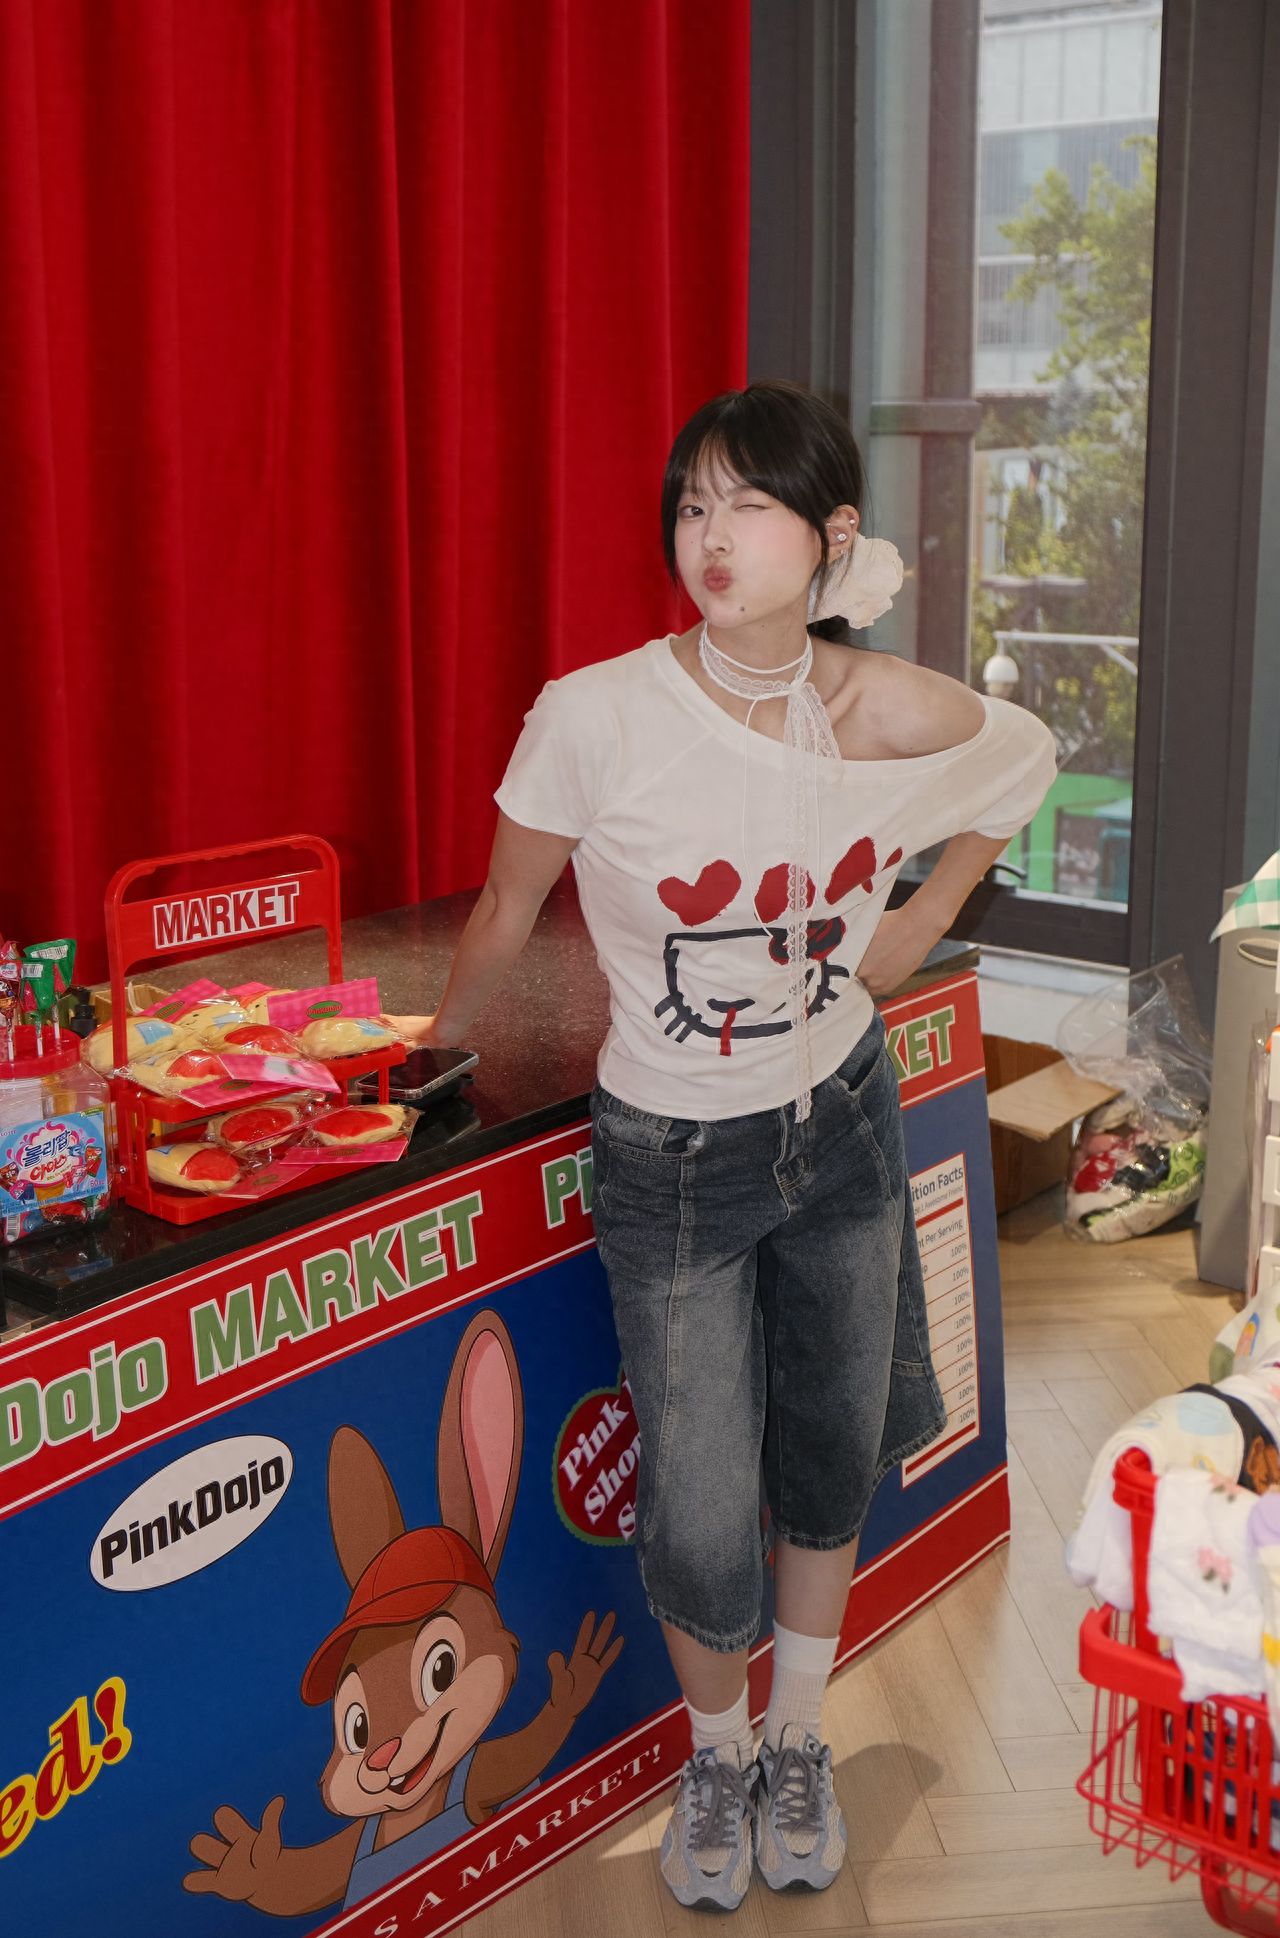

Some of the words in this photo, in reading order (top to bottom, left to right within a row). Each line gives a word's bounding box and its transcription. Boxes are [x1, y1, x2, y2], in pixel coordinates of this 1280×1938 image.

[153, 881, 300, 949] MARKET
[190, 1190, 483, 1386] MARKET
[885, 1004, 955, 1083] KET
[911, 1181, 936, 1202] ition
[937, 1167, 964, 1190] Facts
[925, 1232, 937, 1246] Per
[938, 1218, 963, 1238] Serving
[951, 1243, 967, 1258] 100%
[952, 1266, 969, 1281] 100%
[954, 1289, 970, 1305] 100%
[954, 1313, 971, 1330] 100%
[957, 1336, 973, 1353] 100%
[958, 1361, 974, 1377] 100%
[959, 1384, 975, 1400] 100%
[959, 1407, 976, 1423] 100%
[559, 1399, 629, 1491] Pink
[101, 1456, 285, 1580] PinkDojo
[618, 1501, 636, 1543] S
[412, 1890, 448, 1921] A
[459, 1743, 662, 1891] MARKET!
